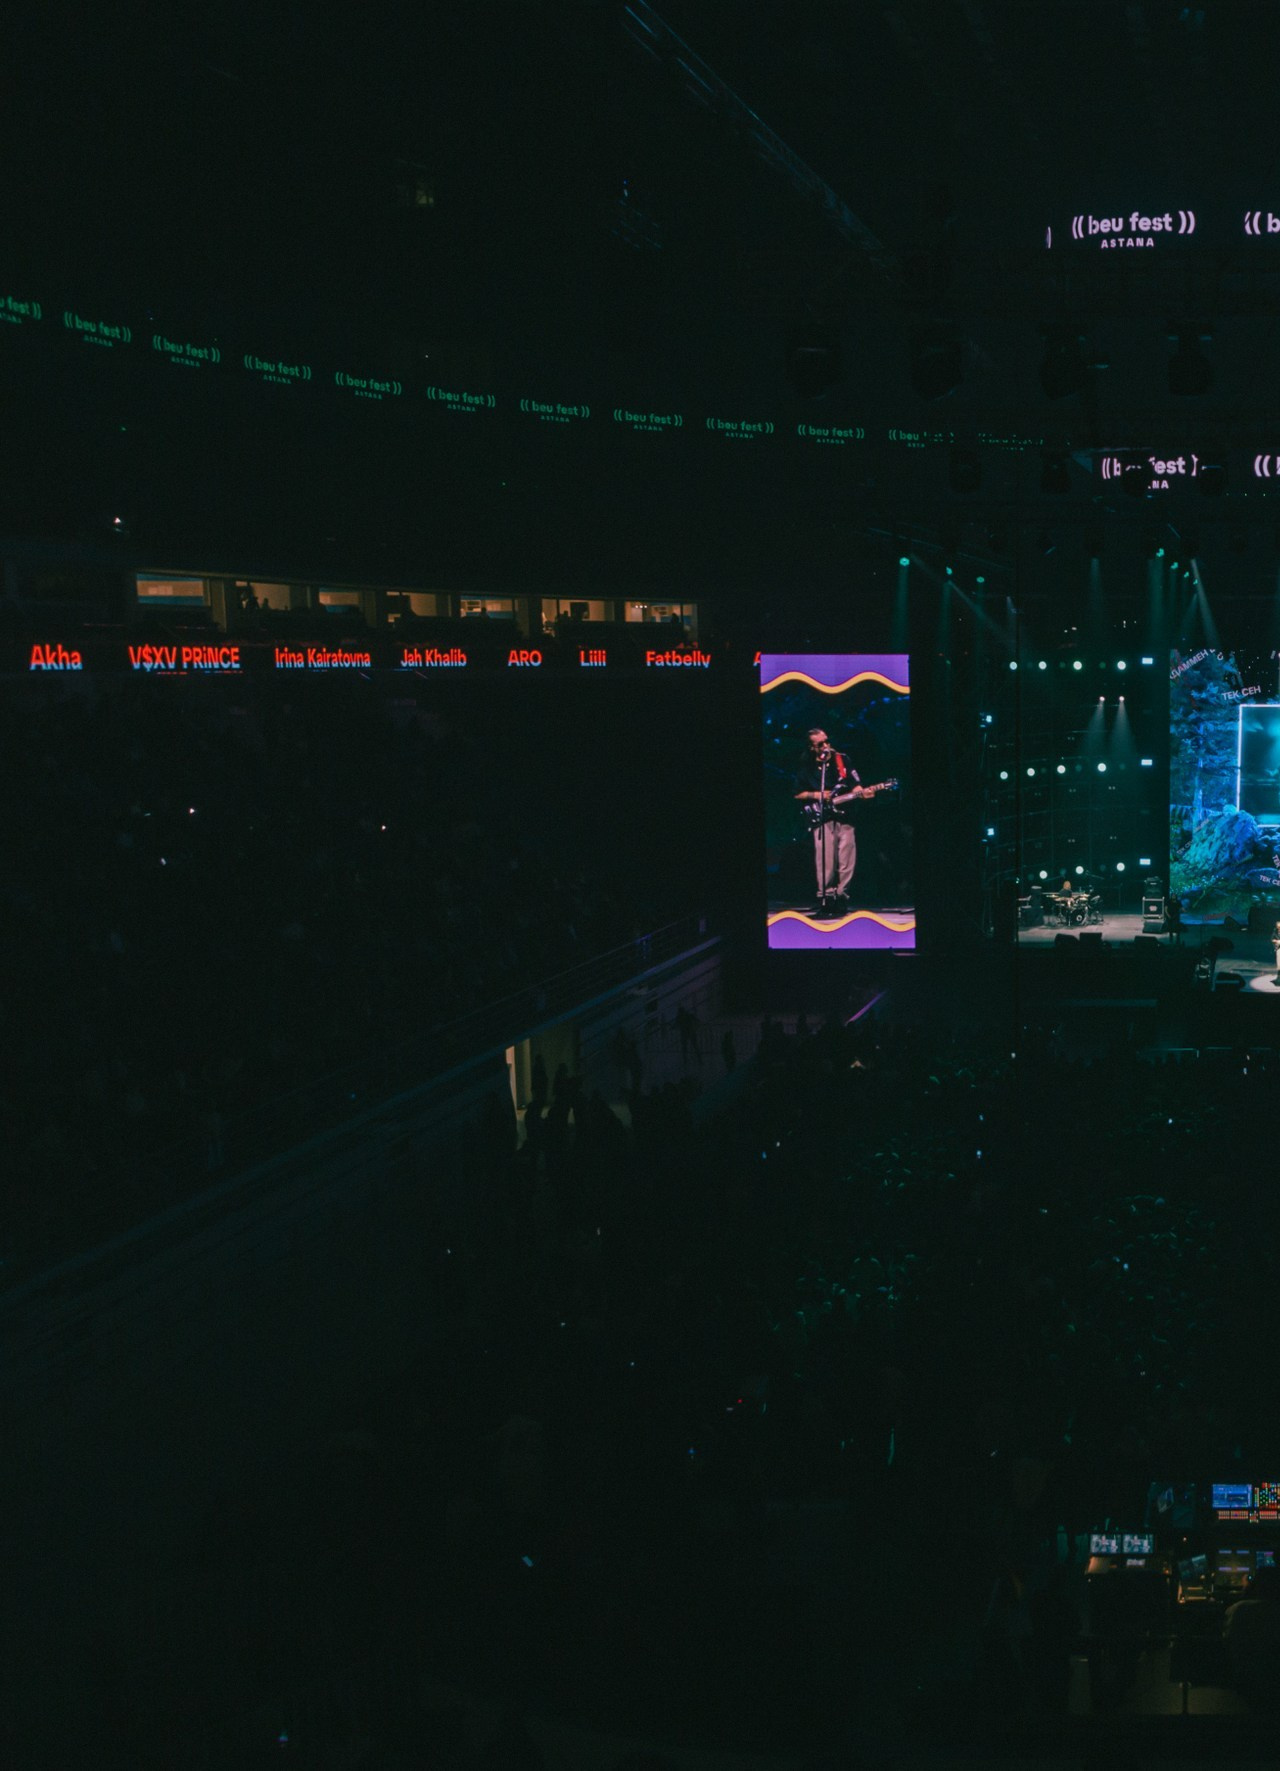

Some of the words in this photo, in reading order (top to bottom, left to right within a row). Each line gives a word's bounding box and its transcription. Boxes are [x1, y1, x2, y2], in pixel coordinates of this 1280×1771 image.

[1088, 215, 1123, 235] beu
[1129, 211, 1173, 232] fest
[1100, 237, 1154, 249] ASTANA
[29, 643, 84, 671] Akha
[128, 643, 177, 673] V$XV
[275, 647, 304, 669] Irina
[307, 647, 371, 669] Kairatovna
[400, 649, 422, 667] Jah
[425, 648, 467, 667] Khalib
[507, 650, 543, 667] ARO
[646, 650, 712, 669] Fatbelly
[1221, 690, 1241, 701] ТЕК
[1241, 685, 1262, 697] СЕН
